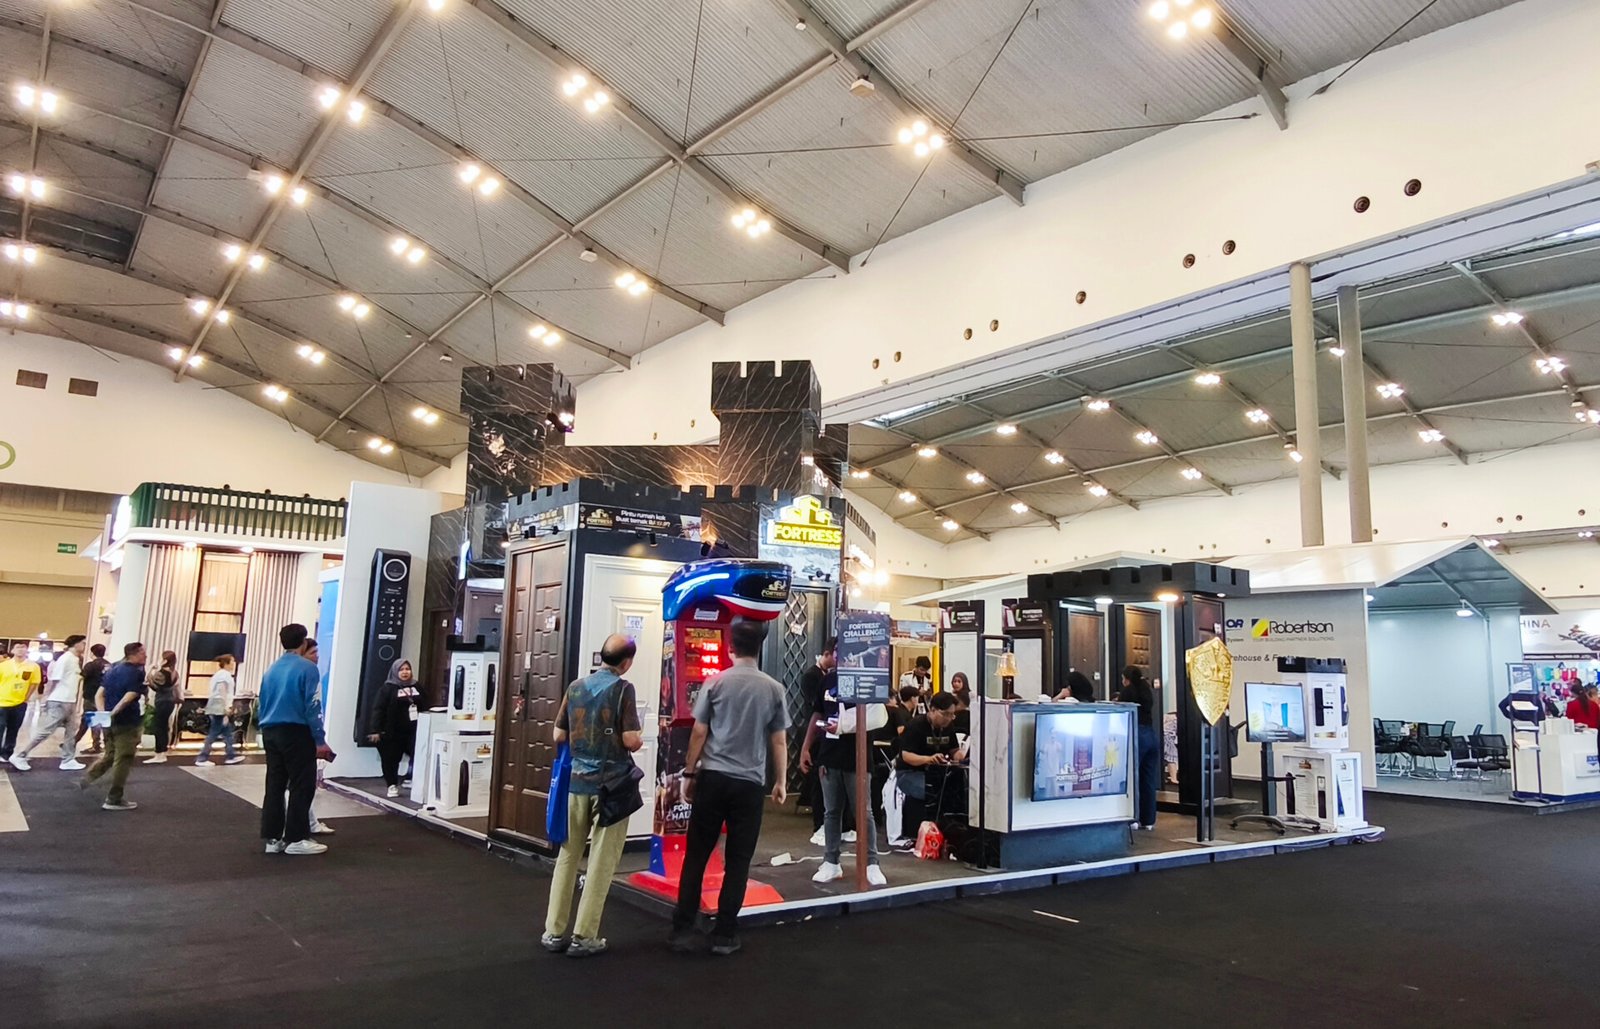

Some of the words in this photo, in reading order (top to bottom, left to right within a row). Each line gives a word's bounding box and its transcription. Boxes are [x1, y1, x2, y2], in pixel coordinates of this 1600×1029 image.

[774, 524, 843, 543] FORTRESS
[848, 622, 880, 630] FORTRESS
[1269, 620, 1334, 634] Robertson
[1520, 619, 1551, 628] HINA
